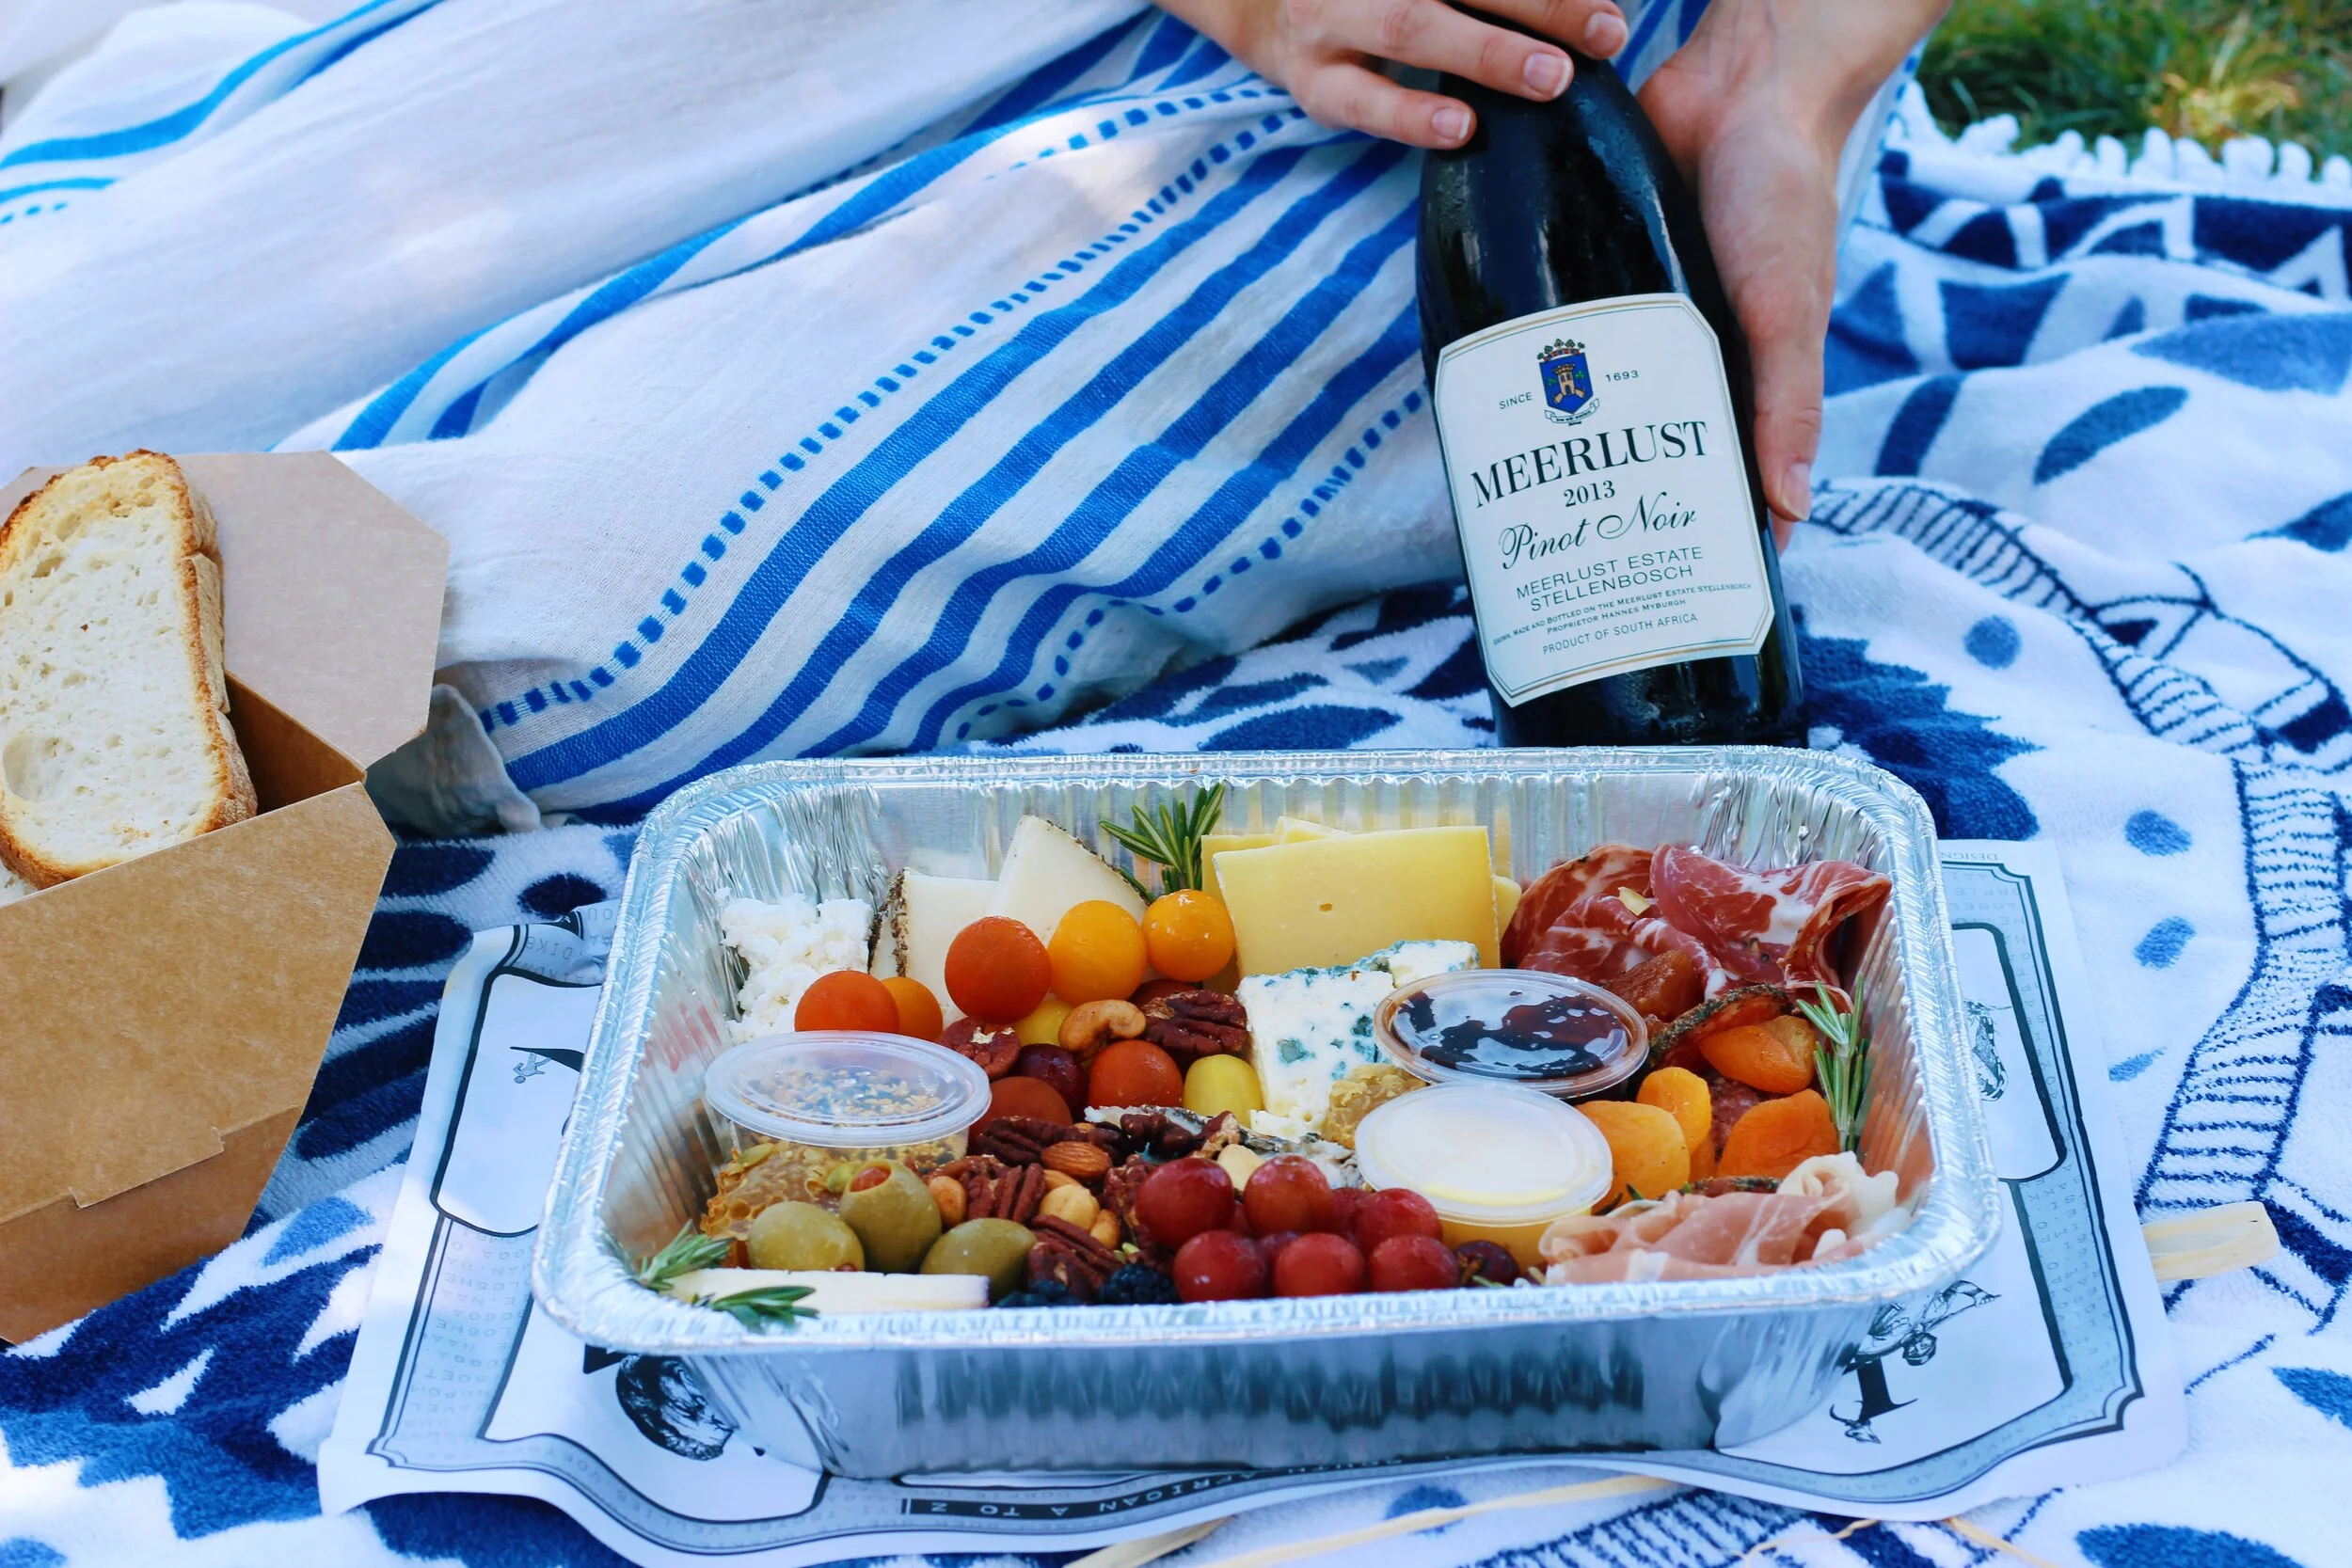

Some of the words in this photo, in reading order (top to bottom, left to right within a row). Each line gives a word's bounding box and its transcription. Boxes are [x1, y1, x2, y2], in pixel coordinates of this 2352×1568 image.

[1498, 391, 1533, 410] SINCE
[1606, 370, 1639, 383] 1693
[1470, 420, 1708, 509] MEERLUST
[1564, 480, 1615, 508] 2013
[1498, 518, 1591, 570] Pinot
[1597, 491, 1697, 540] Noir
[1517, 559, 1619, 599] MEERLUST
[1628, 546, 1704, 569] ESTATE
[1531, 564, 1693, 611] STELLENBOSCH
[1532, 620, 1545, 629] AND
[1547, 610, 1581, 624] BOTTLED
[1597, 600, 1613, 610] THE
[1617, 592, 1662, 606] MEERLUST
[1665, 587, 1695, 597] ESTATE
[1547, 615, 1598, 635] PROPRIETOR
[1602, 606, 1639, 619] HANNES
[1643, 599, 1686, 611] MYBURGH
[1543, 633, 1590, 655] PRODUCT
[1594, 629, 1609, 641] OF
[1613, 620, 1653, 636] SOUTH
[1657, 613, 1698, 627] AFRICA
[930, 1502, 947, 1513] Z
[978, 1504, 1021, 1516] TO
[1048, 1506, 1069, 1517] A
